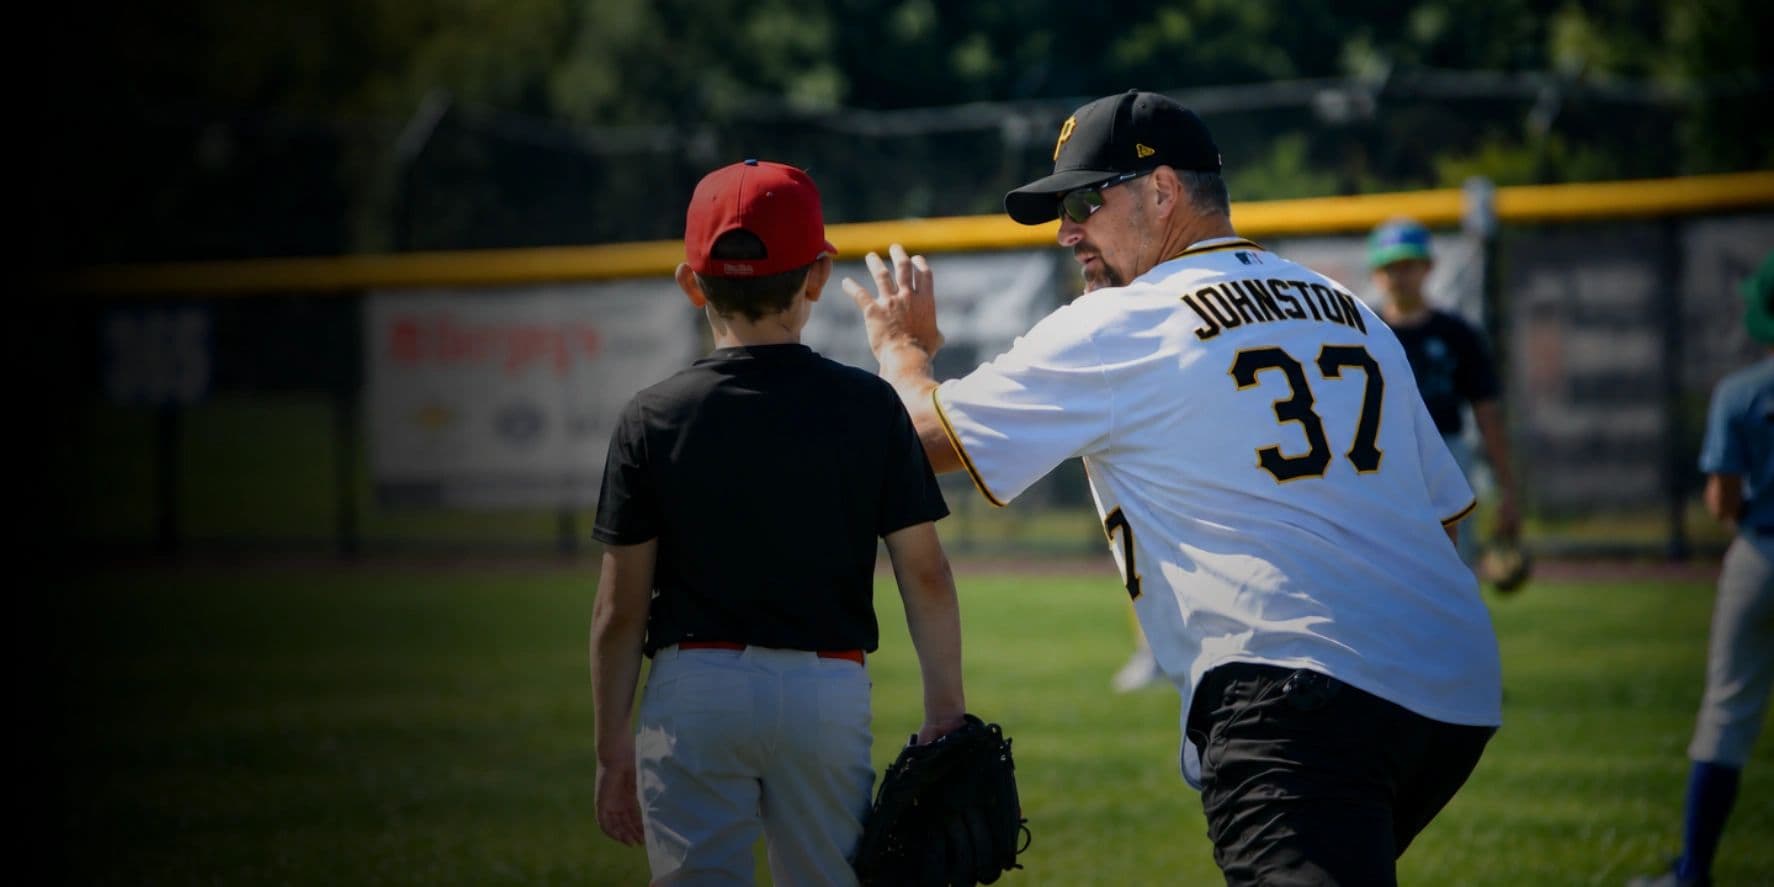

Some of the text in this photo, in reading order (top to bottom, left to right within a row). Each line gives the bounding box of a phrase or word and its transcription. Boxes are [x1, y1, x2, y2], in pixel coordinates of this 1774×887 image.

[1053, 115, 1077, 161] P
[1182, 279, 1367, 339] JOHNSTON
[1229, 344, 1385, 484] 37
